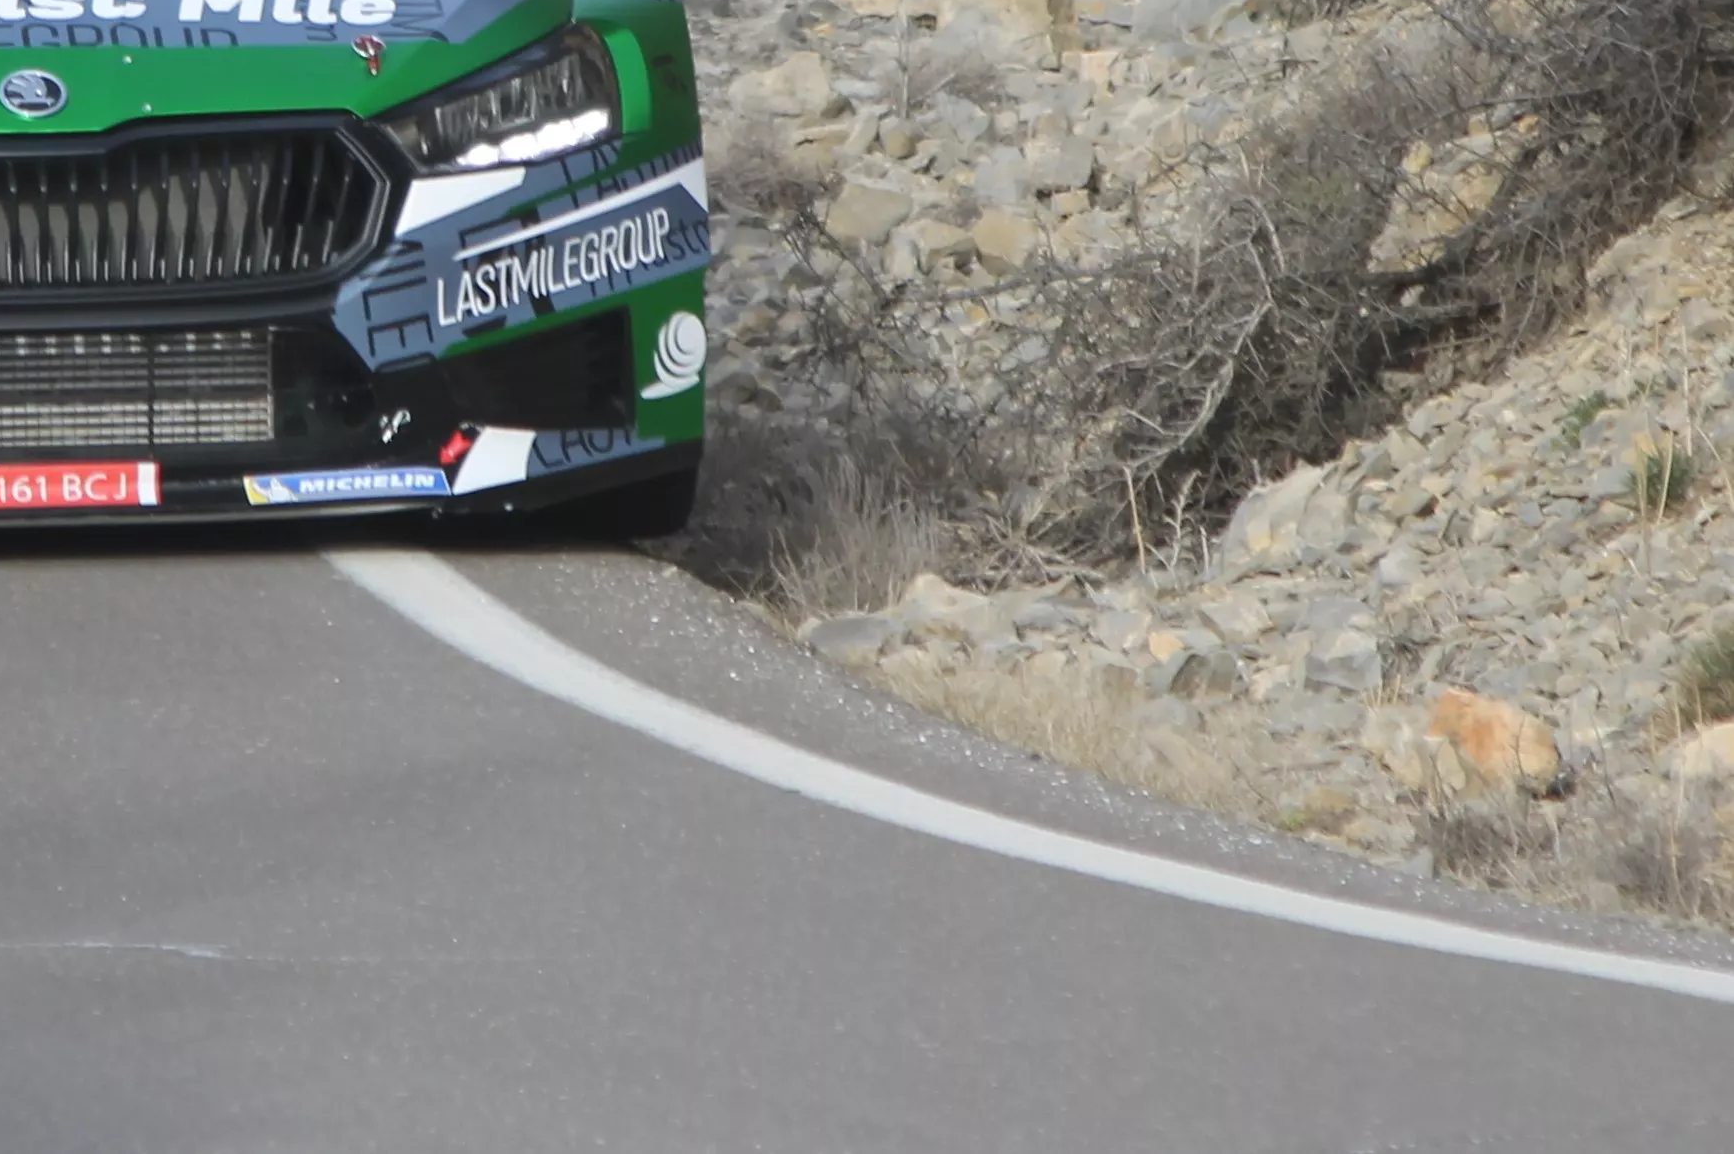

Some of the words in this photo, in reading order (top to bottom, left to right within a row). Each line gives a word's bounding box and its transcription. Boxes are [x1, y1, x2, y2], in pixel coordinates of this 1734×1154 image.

[437, 206, 671, 327] LASTMILEGROUP
[63, 473, 128, 502] BCJ
[299, 471, 436, 492] MICHELIN
